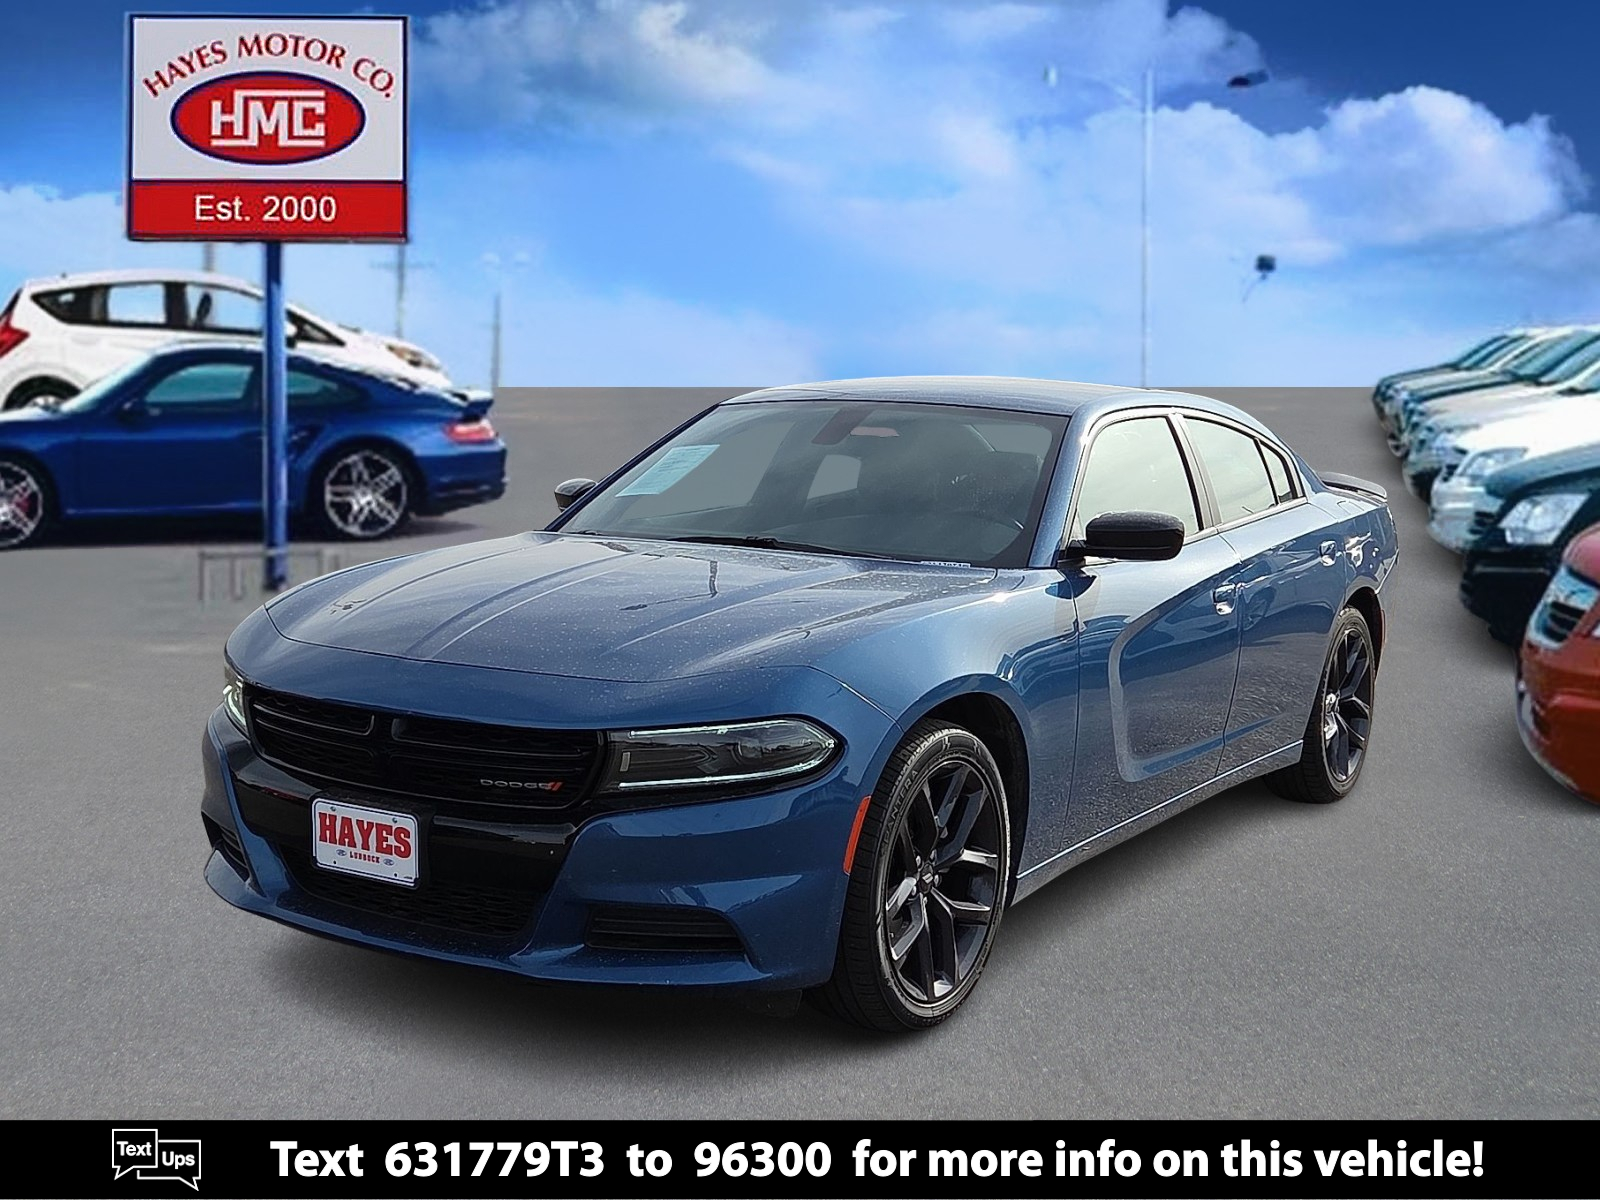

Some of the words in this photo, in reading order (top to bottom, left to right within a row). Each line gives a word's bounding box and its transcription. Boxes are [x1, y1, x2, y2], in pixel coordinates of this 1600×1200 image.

[142, 40, 227, 97] HAYES
[238, 33, 346, 69] MOTOR
[352, 57, 394, 98] CO.
[210, 89, 326, 147] HMC
[194, 194, 251, 221] Est.
[262, 195, 337, 222] 2000
[480, 779, 553, 790] DODGE
[318, 812, 411, 859] HAYES
